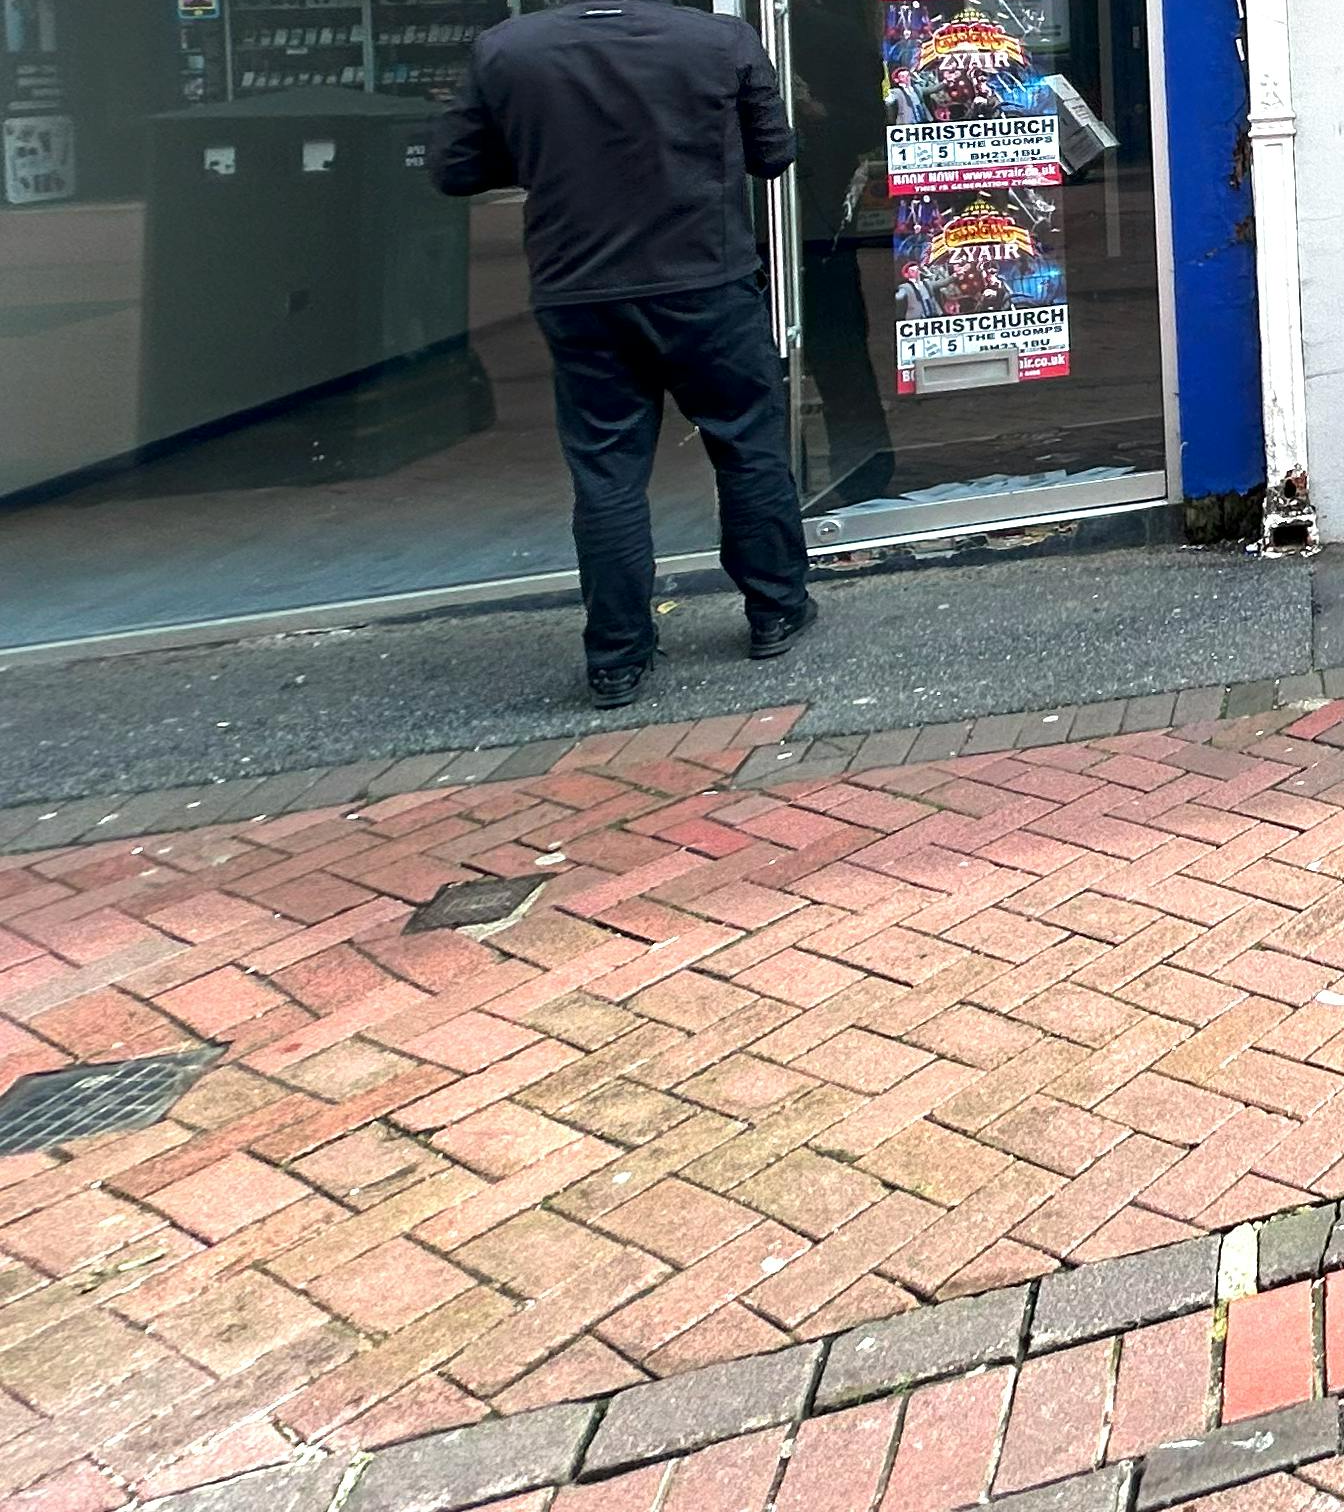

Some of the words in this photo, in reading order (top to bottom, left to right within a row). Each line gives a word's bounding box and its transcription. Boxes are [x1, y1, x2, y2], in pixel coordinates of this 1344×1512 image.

[939, 52, 1011, 70] ZYAIR
[890, 119, 1054, 143] CHRISTCHURCH
[957, 140, 986, 149] THE
[991, 136, 1053, 146] QUOMPS
[898, 148, 906, 161] 1
[938, 146, 948, 159] 5
[949, 243, 1020, 264] ZYAIR
[900, 308, 1064, 338] CHRISTCHURCH
[968, 332, 996, 342] THE
[1000, 326, 1062, 338] QUOMPS
[907, 344, 916, 357] 1
[947, 340, 957, 352] 5
